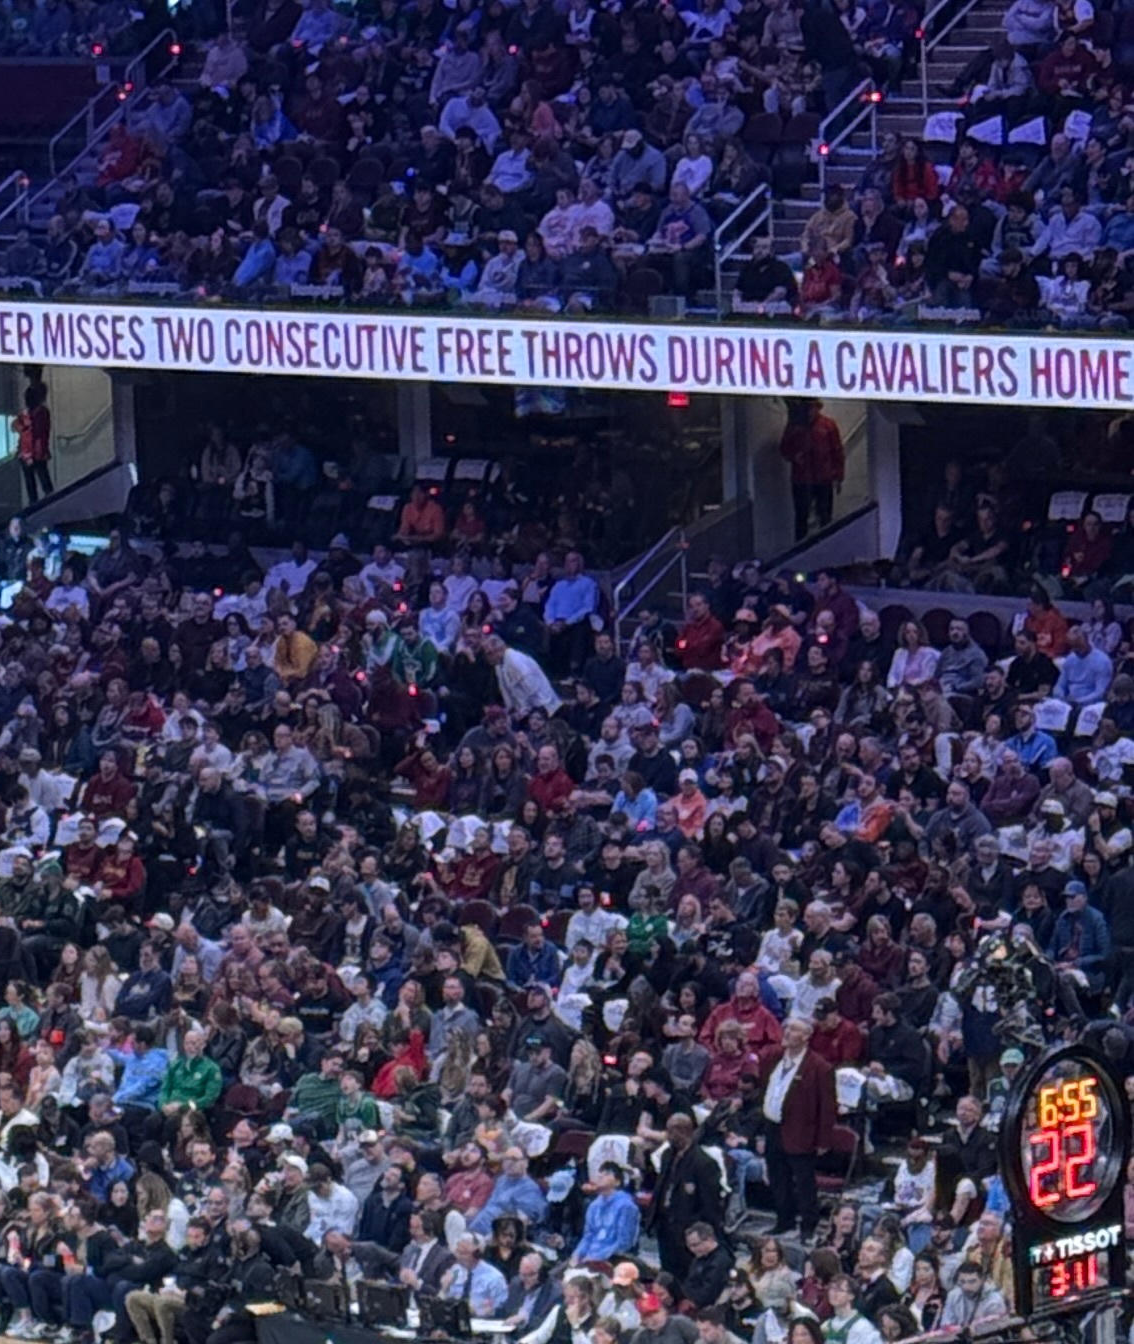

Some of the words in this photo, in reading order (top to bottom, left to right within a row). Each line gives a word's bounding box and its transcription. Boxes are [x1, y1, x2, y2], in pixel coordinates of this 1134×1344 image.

[43, 313, 145, 360] MISSES
[154, 317, 214, 363] TWO
[225, 320, 428, 373] CONSECUTIVE
[437, 327, 515, 377] FREE
[522, 331, 657, 382] THROWS
[669, 336, 794, 387] DURING
[805, 341, 826, 390] A
[836, 342, 1017, 396] CAVALIERS
[1031, 347, 1133, 402] HOME
[1040, 1076, 1098, 1128] 6:55
[1029, 1121, 1096, 1207] 22
[1056, 1224, 1122, 1259] TISSOT
